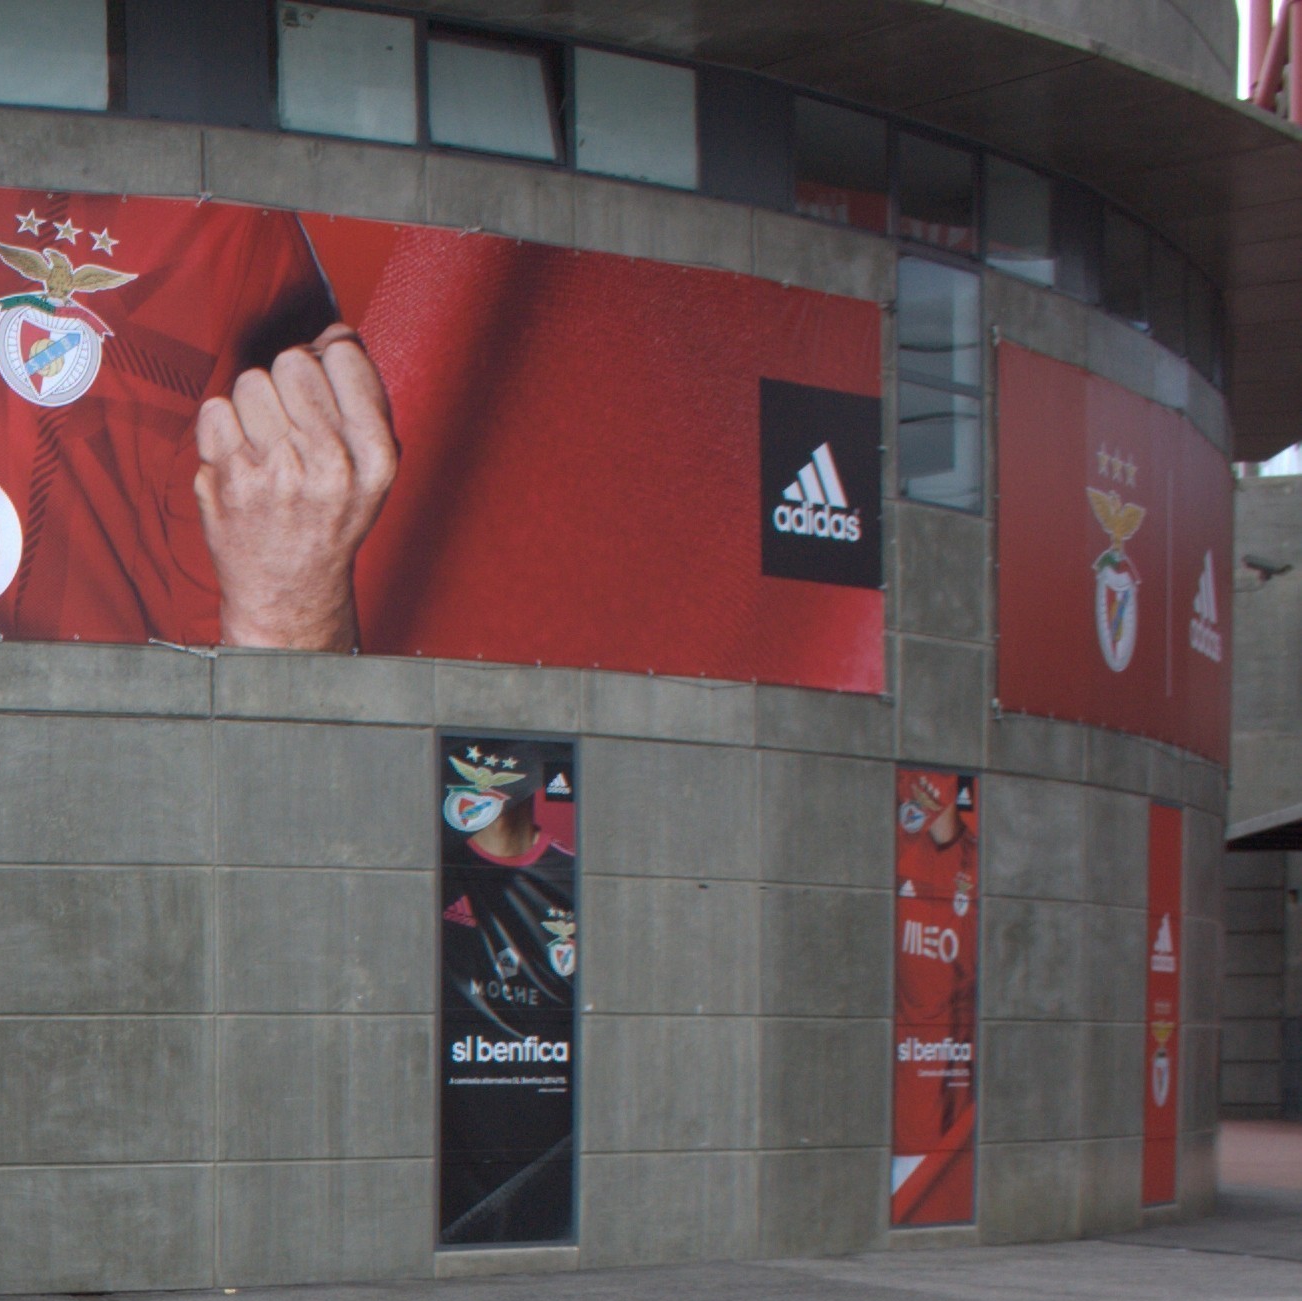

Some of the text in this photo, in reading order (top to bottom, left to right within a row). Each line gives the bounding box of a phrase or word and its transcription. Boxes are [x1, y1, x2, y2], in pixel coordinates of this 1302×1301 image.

[772, 500, 862, 542] adidas
[451, 1035, 571, 1063] sl benfica
